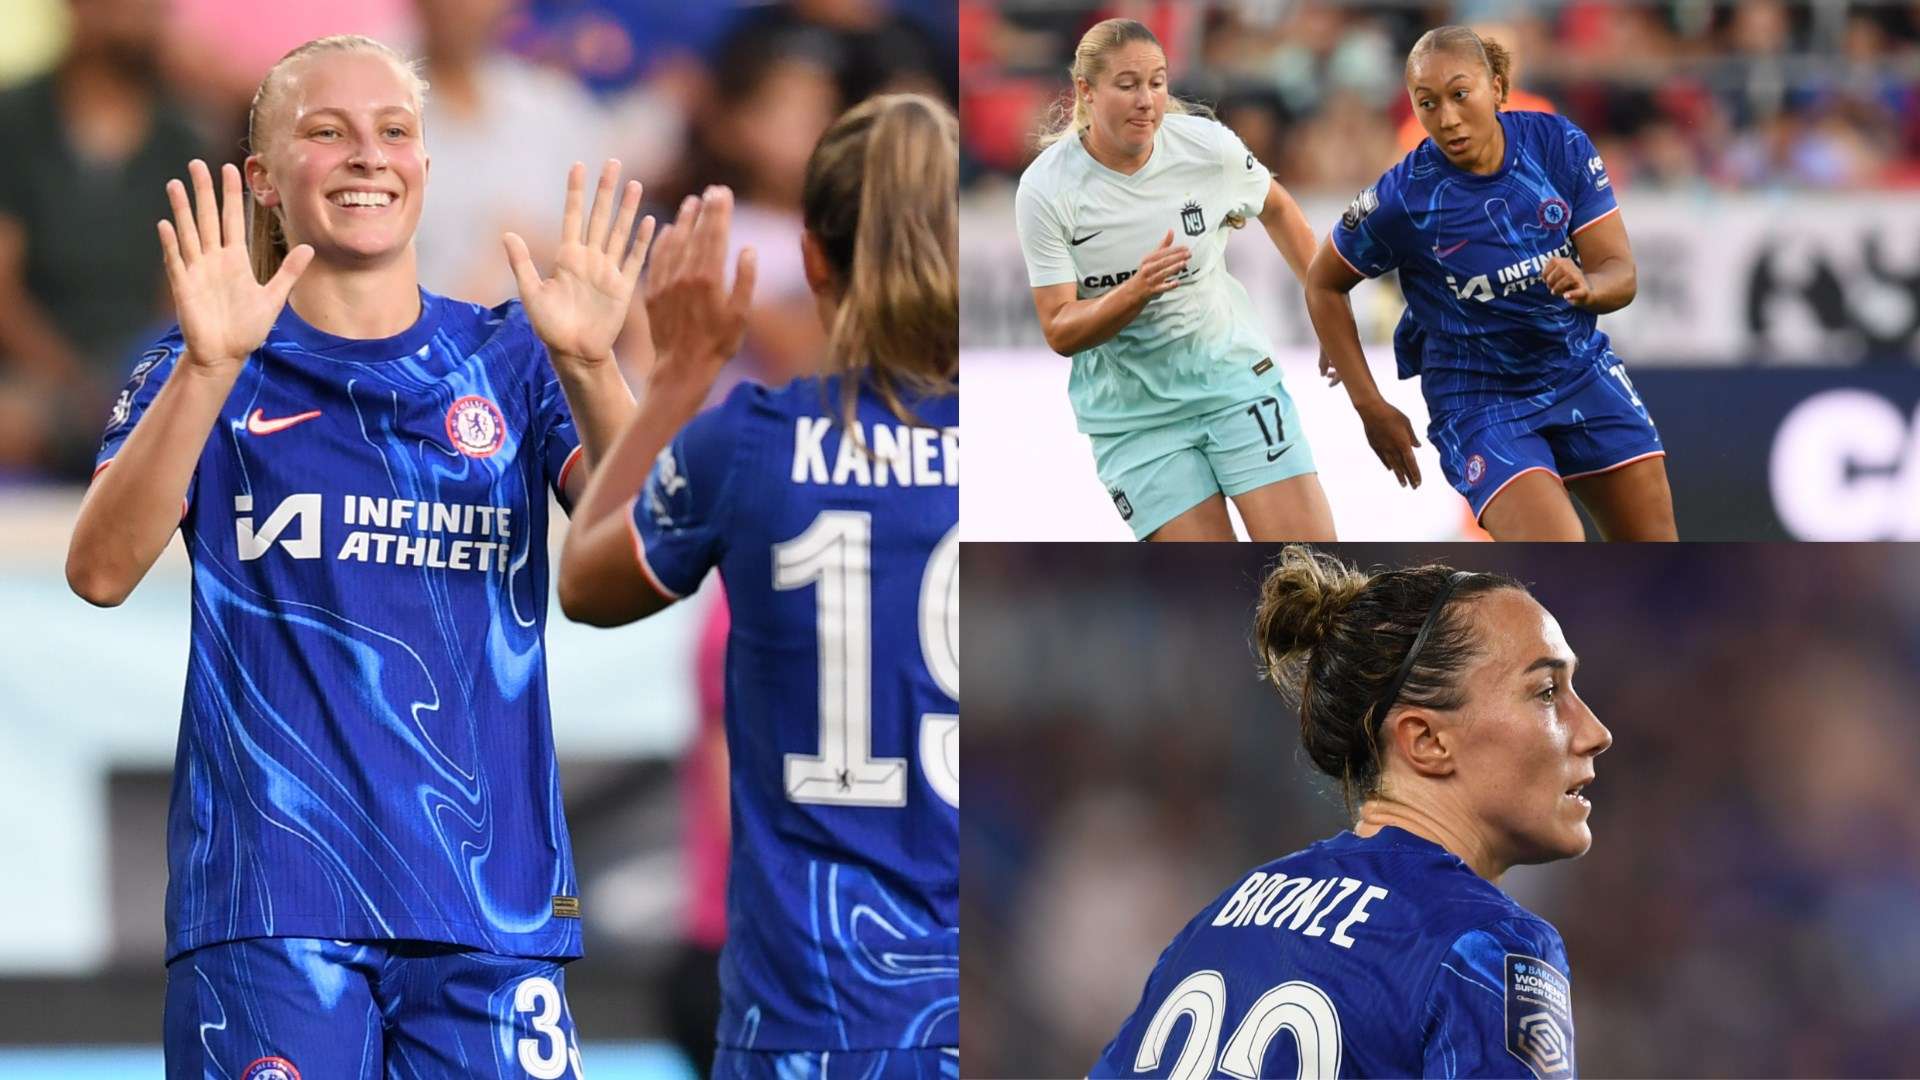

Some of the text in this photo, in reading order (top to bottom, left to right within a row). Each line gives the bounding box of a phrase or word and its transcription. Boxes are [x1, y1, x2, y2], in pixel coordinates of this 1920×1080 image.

[1246, 396, 1285, 446] 17
[343, 494, 511, 537] INFINITE
[337, 531, 510, 573] ATHLETE
[1211, 871, 1388, 949] BRONZE
[1514, 983, 1544, 997] SUPER
